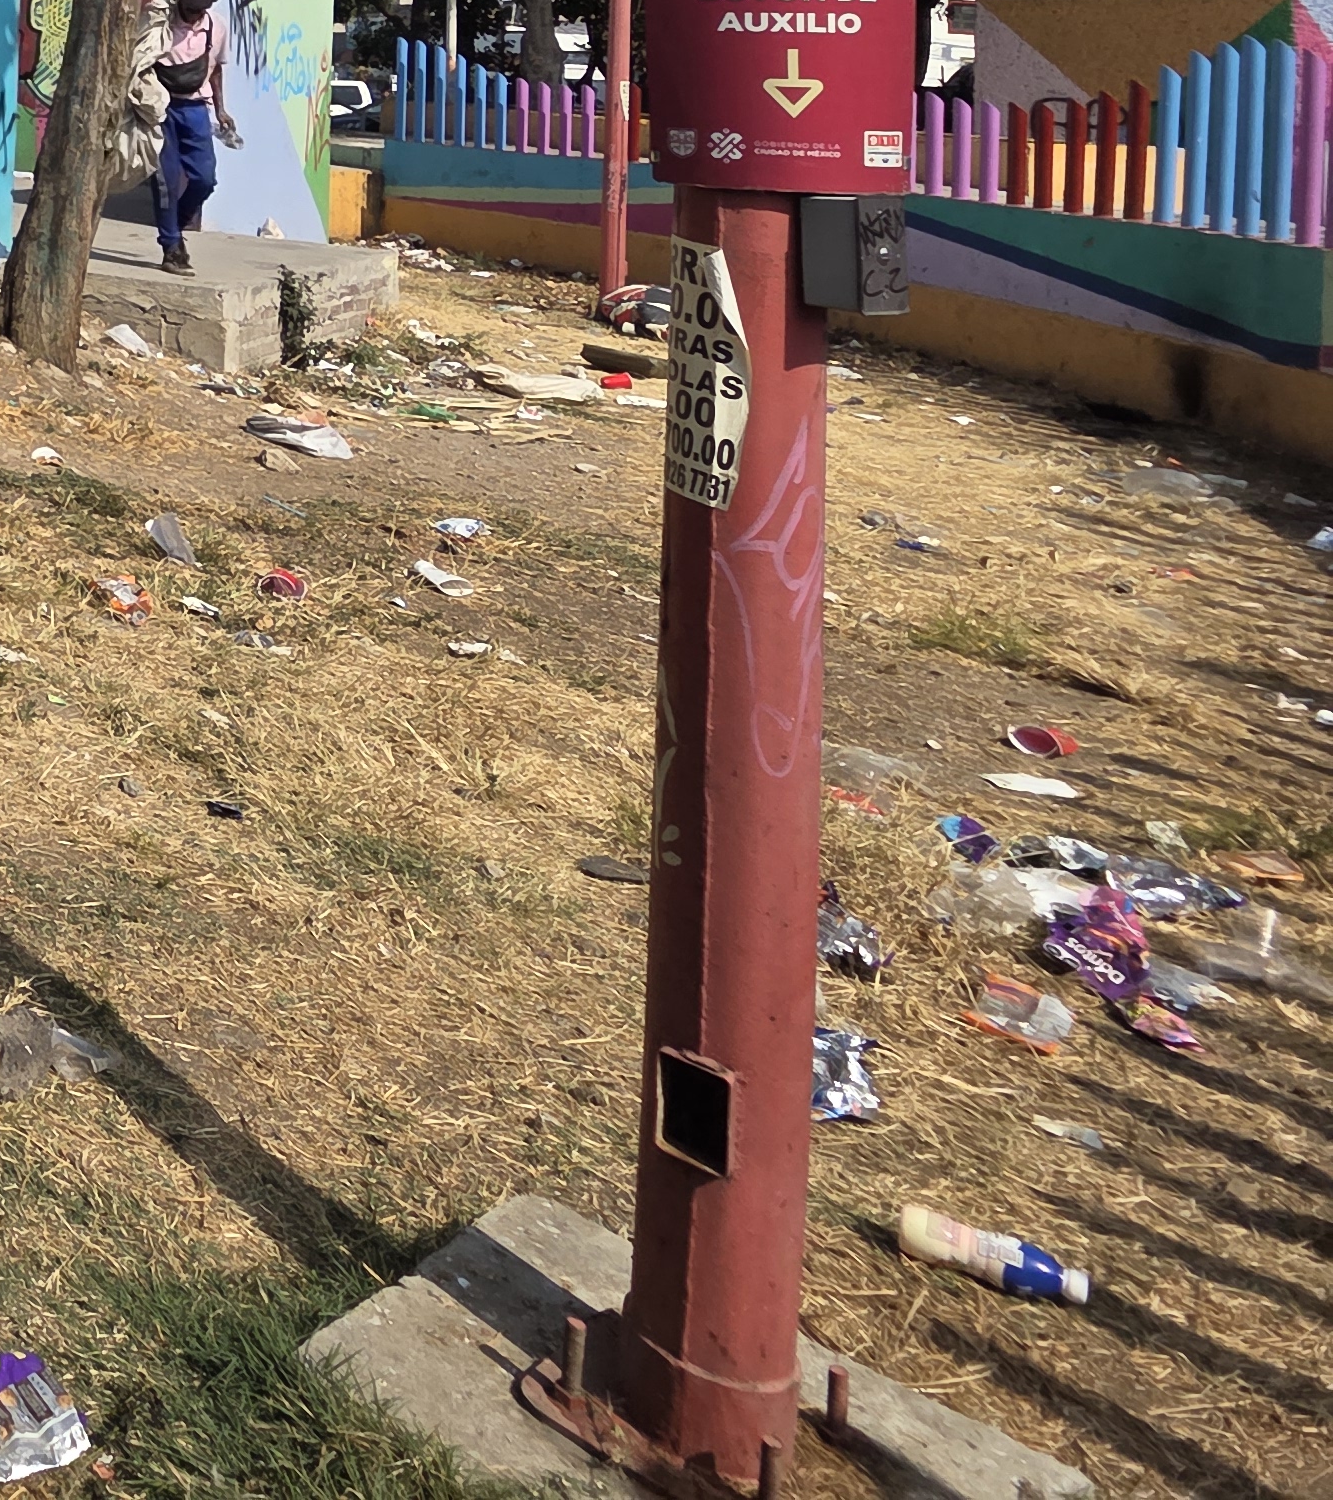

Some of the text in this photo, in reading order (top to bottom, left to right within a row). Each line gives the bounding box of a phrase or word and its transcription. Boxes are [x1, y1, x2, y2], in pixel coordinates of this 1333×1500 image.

[716, 12, 862, 34] AUXILIO
[753, 140, 810, 149] GOBIERNO
[753, 147, 790, 156] CIUDAD
[792, 149, 805, 157] DE
